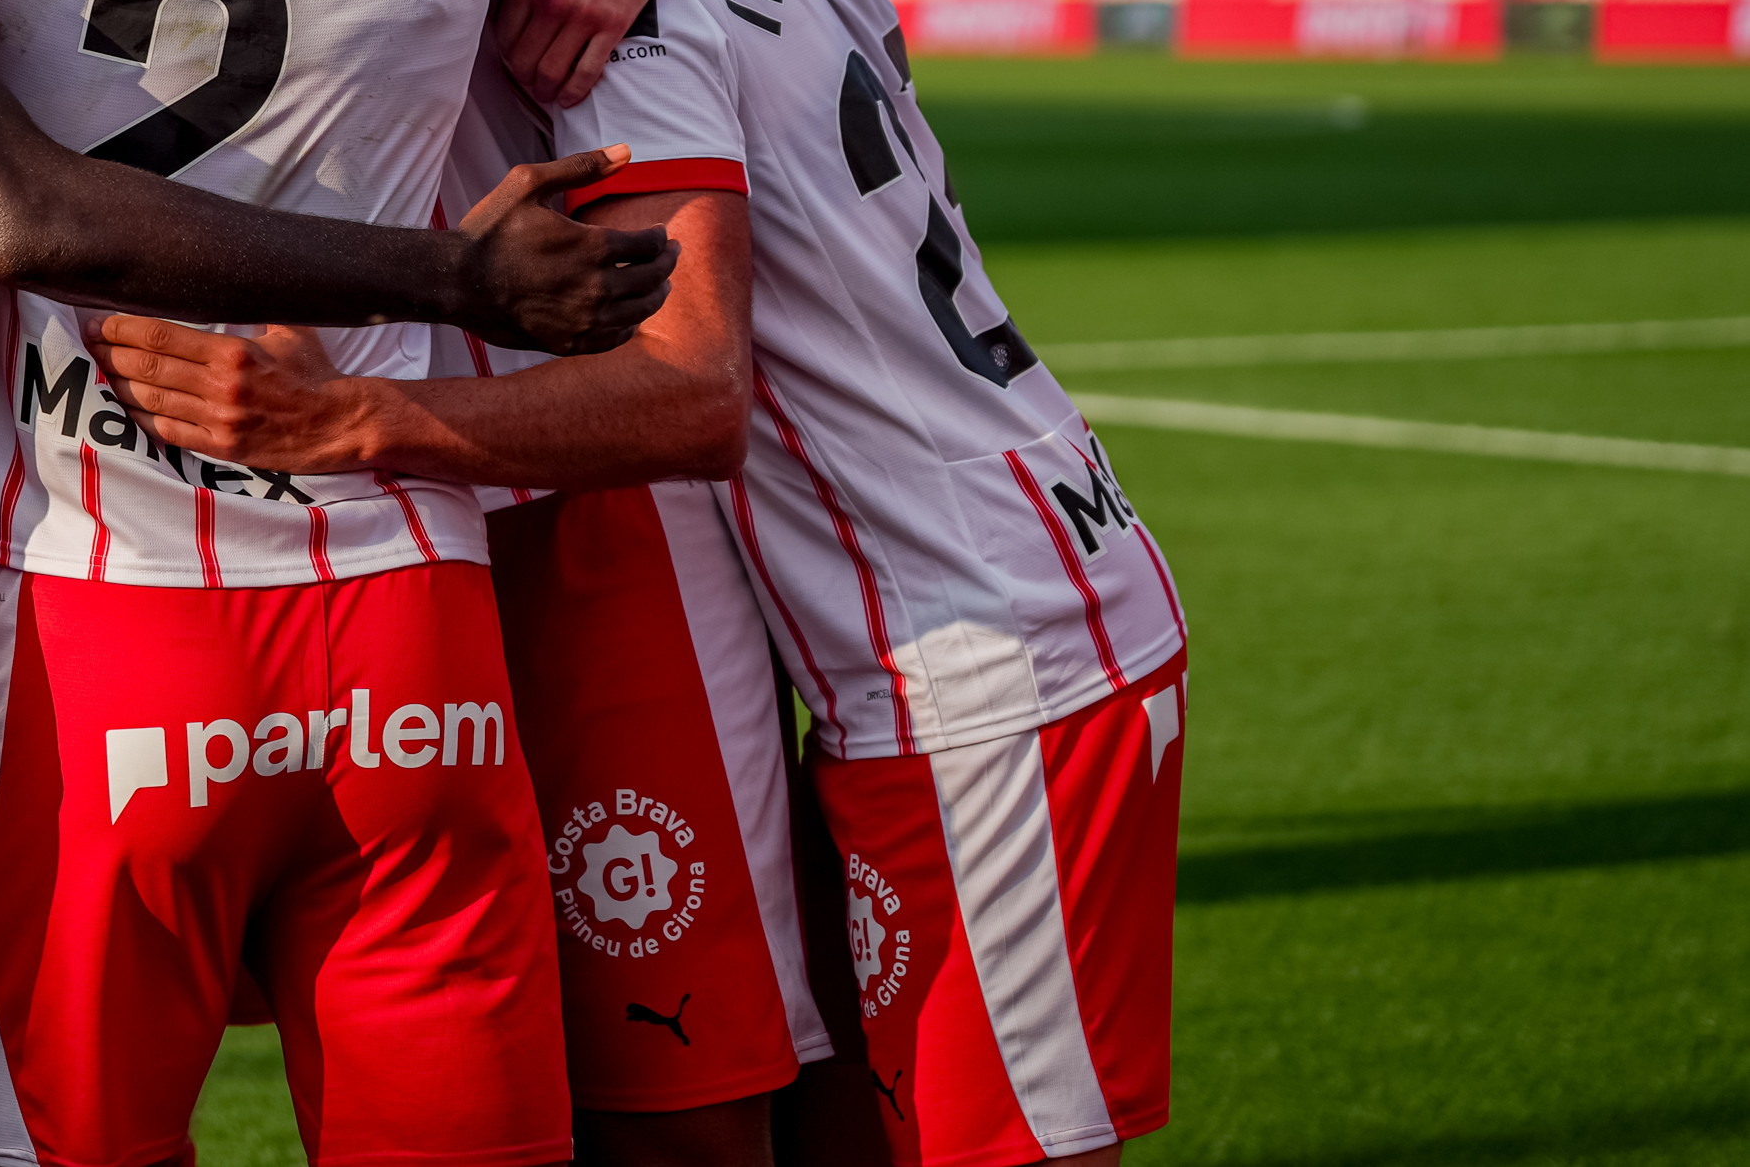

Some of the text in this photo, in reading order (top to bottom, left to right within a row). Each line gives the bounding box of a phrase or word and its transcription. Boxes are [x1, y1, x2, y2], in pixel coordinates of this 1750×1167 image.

[837, 22, 1040, 390] 2
[20, 342, 316, 505] Maex
[186, 689, 505, 808] parlem
[547, 788, 695, 875] Costa Brava
[602, 853, 656, 902] G!
[555, 861, 705, 959] Pirineu de Girona
[849, 853, 901, 916] Brava
[863, 929, 911, 1019] de Girona
